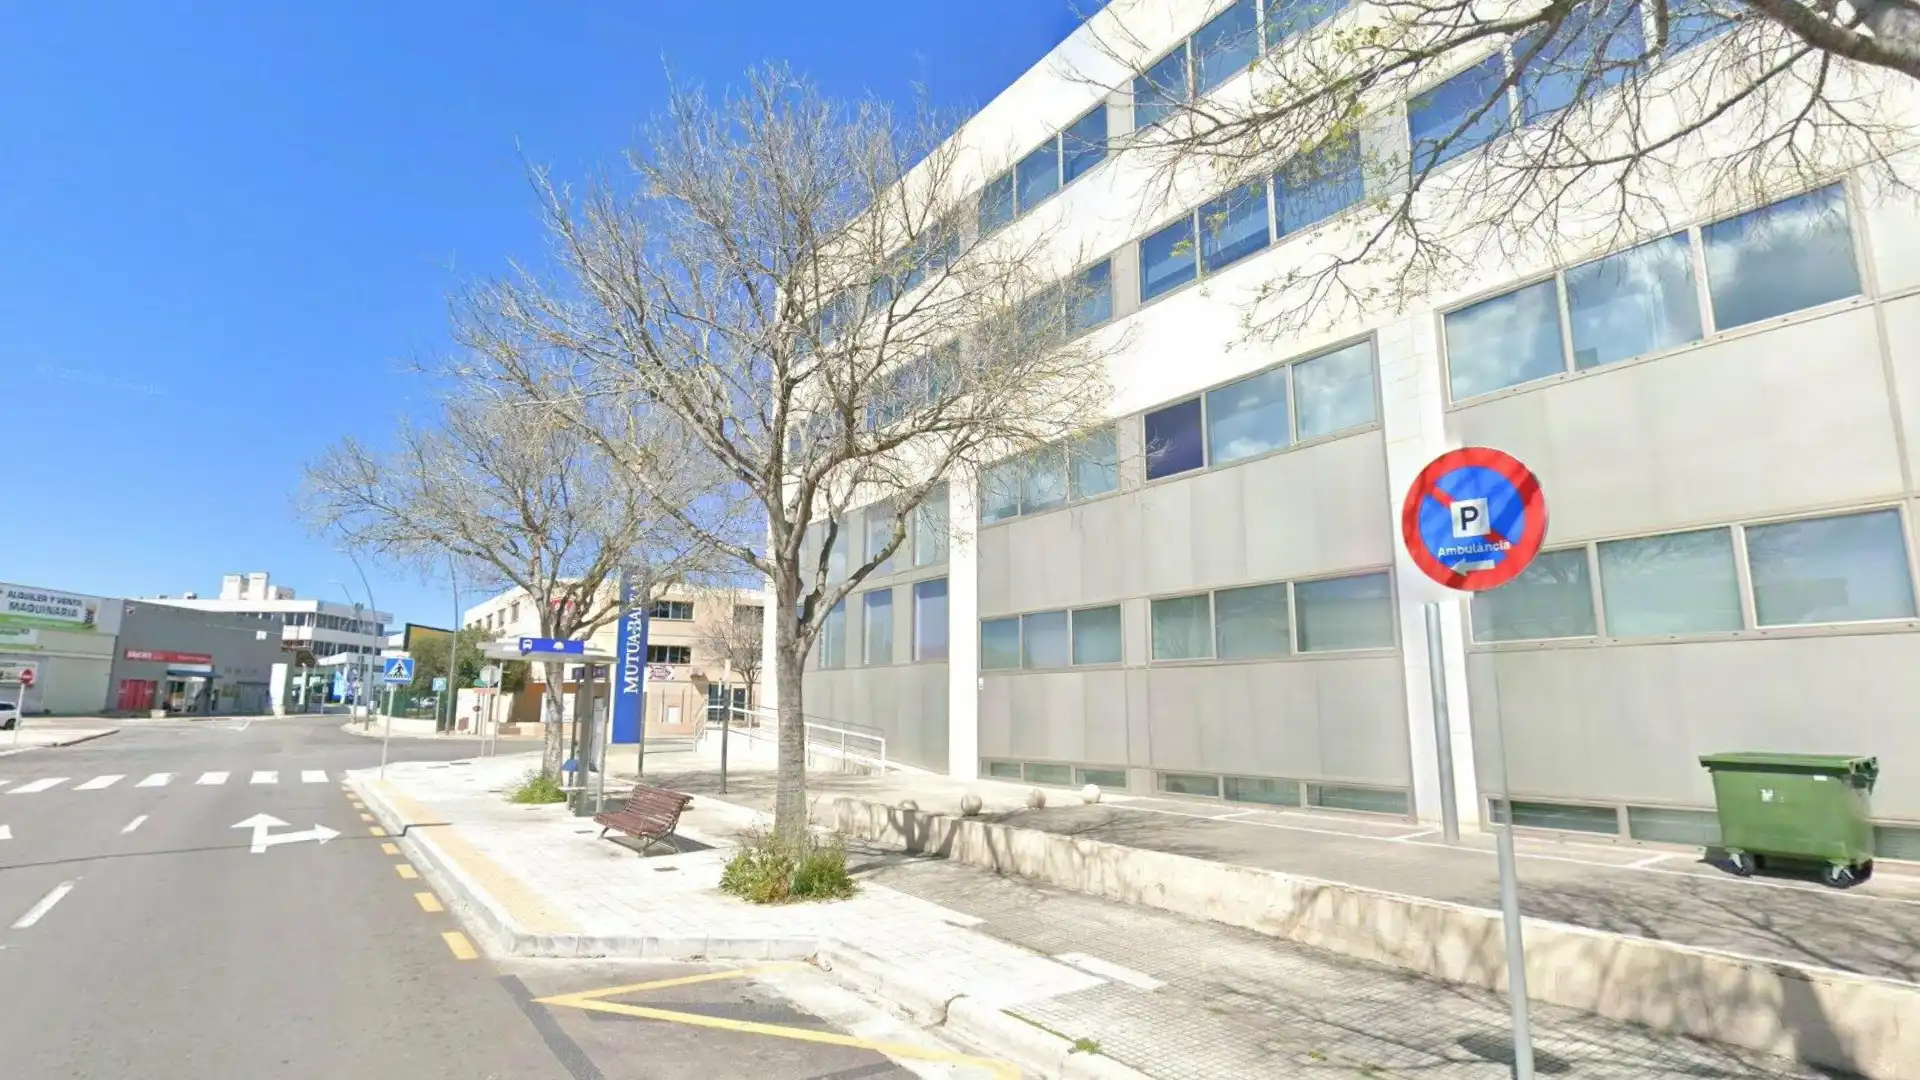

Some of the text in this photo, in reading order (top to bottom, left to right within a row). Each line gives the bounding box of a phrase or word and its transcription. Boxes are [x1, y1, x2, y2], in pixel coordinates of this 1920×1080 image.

[1460, 505, 1479, 531] P
[8, 590, 48, 602] ALQUILER
[57, 597, 82, 606] VENTA
[8, 601, 78, 617] MAQUINARIA
